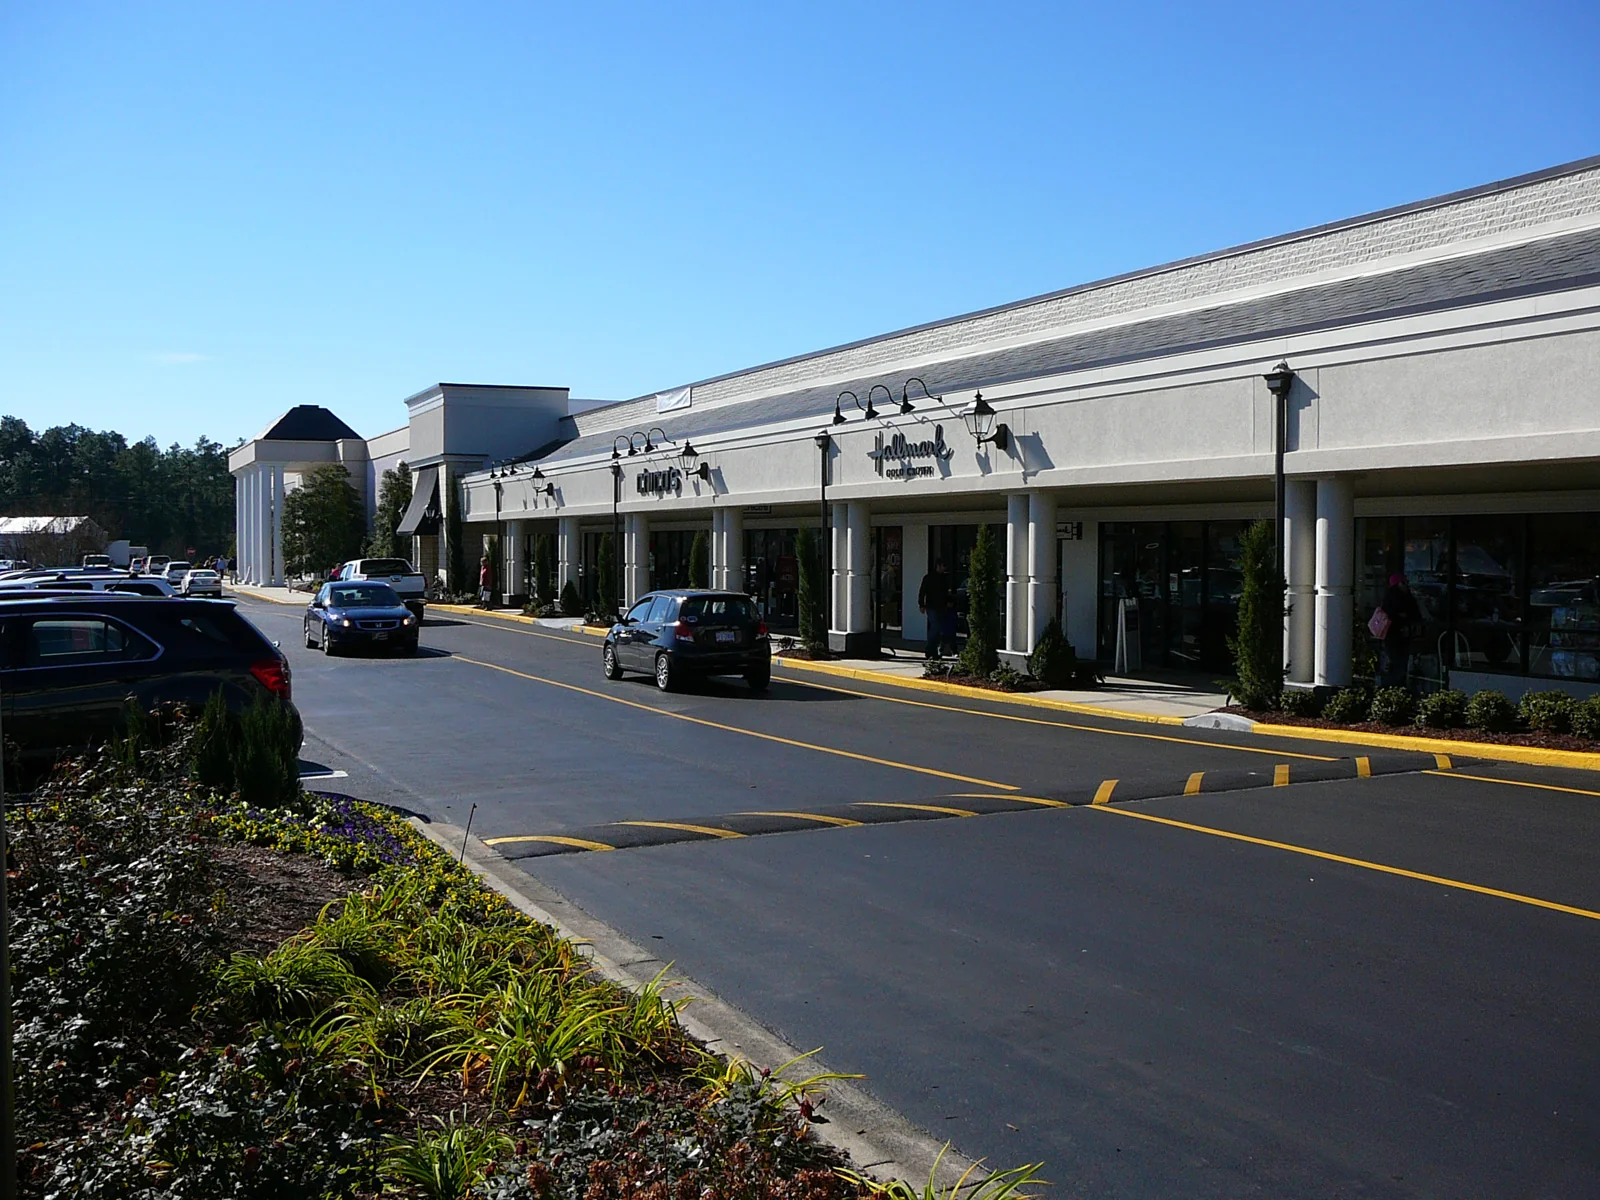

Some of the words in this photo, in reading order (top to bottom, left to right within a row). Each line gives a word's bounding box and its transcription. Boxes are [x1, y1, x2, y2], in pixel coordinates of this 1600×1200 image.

[867, 424, 955, 478] Hallmark
[886, 468, 904, 478] GOLD
[906, 466, 935, 478] CROWN
